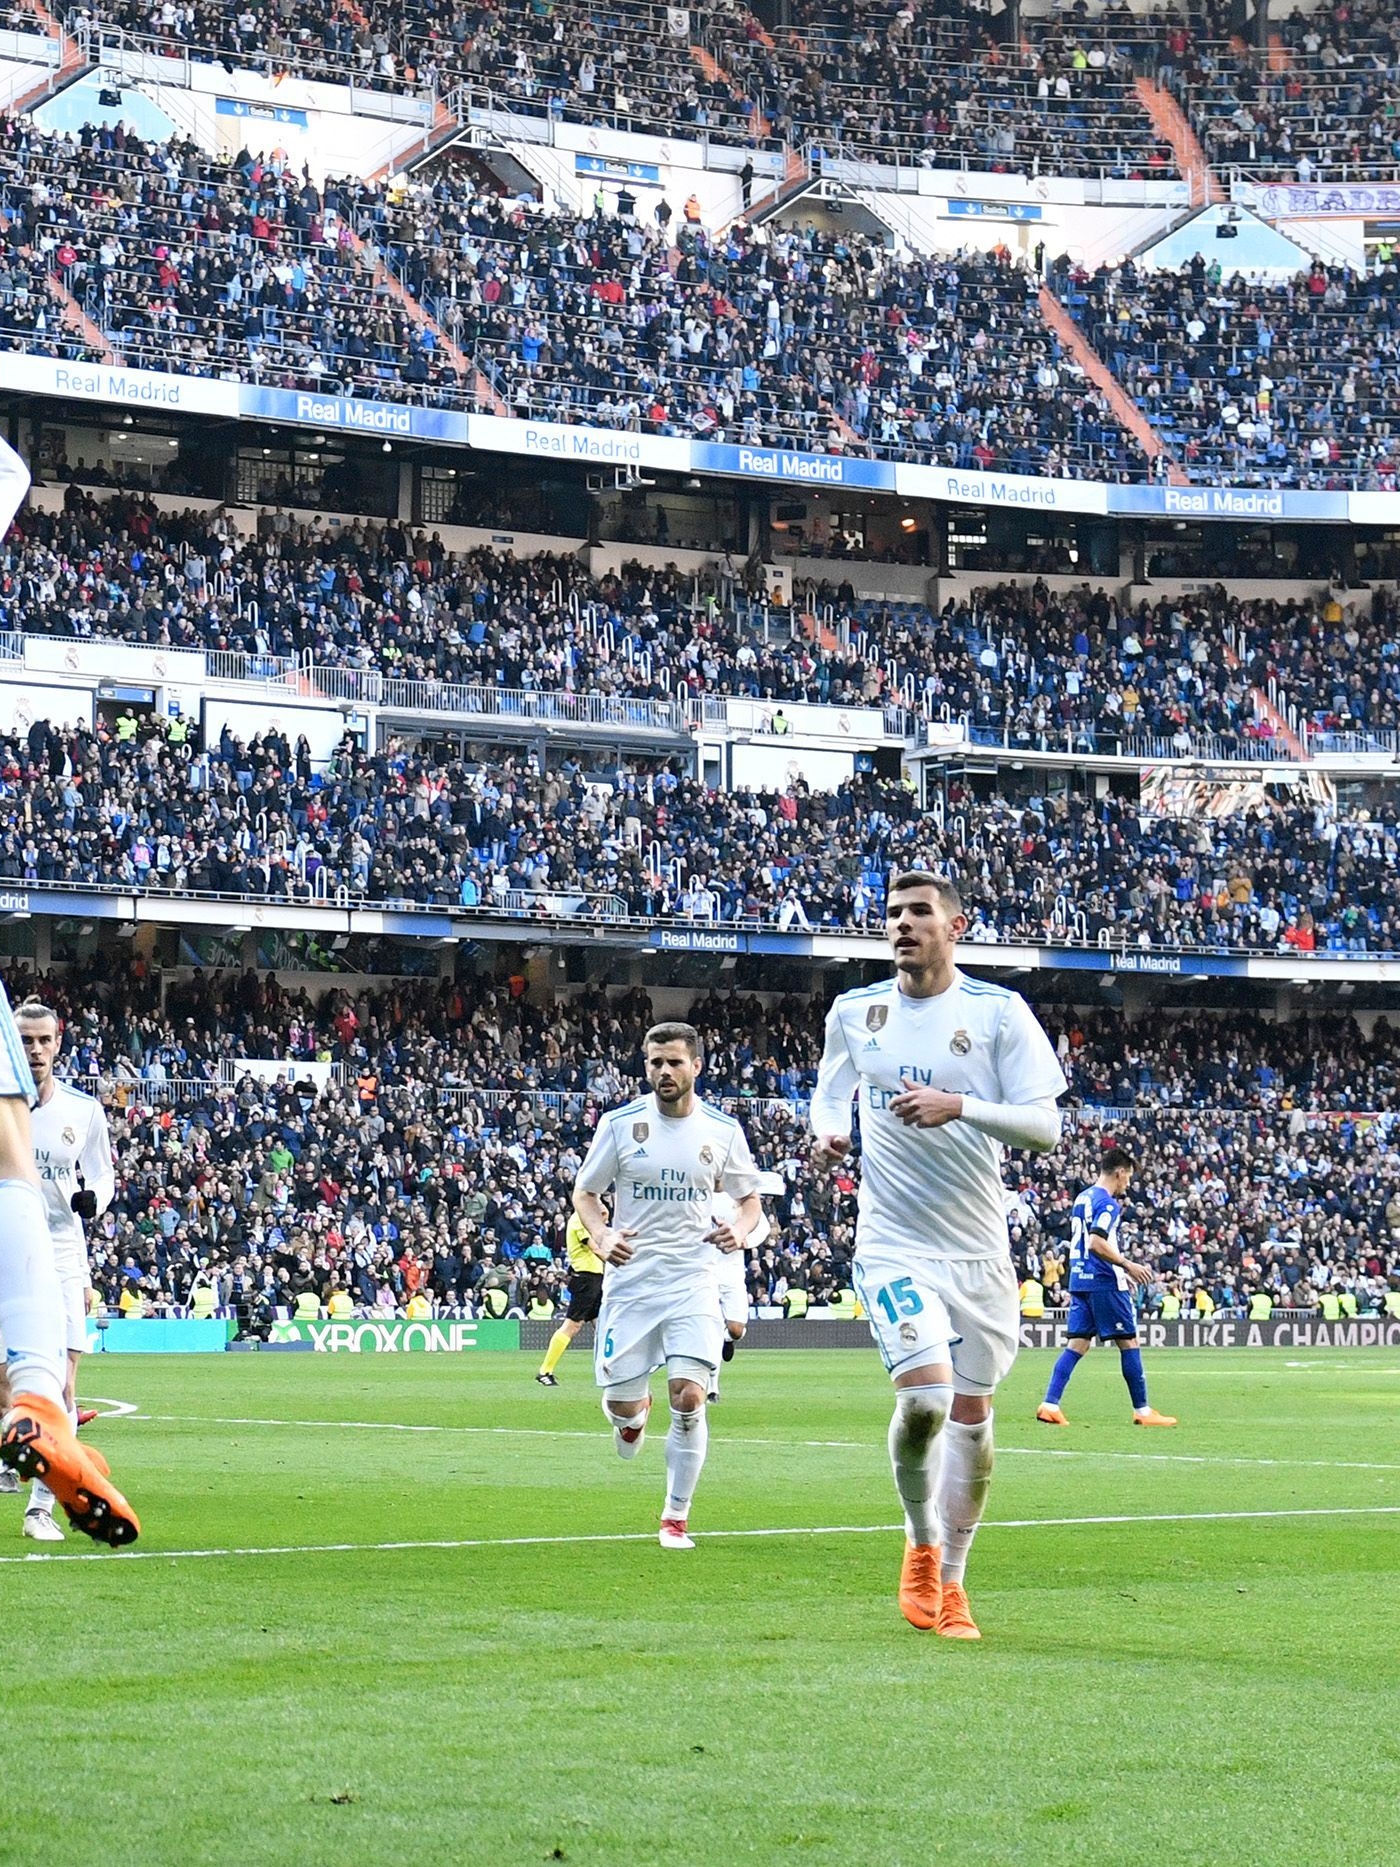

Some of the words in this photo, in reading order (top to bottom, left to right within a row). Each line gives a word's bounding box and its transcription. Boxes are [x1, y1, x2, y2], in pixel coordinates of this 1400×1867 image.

[56, 369, 101, 393] Real
[109, 376, 180, 403] Madrid
[298, 397, 339, 421] Real
[345, 403, 410, 431] Madrid
[526, 430, 566, 452] Real
[573, 435, 640, 459] Madrid
[739, 450, 778, 473] Real
[782, 456, 843, 481] Madrid
[947, 478, 985, 499] Real
[991, 483, 1055, 504] Madrid
[1165, 491, 1208, 512] Real
[1213, 493, 1282, 514] Madrid
[661, 931, 690, 947] Real
[692, 932, 737, 950] Madrid
[1110, 953, 1137, 969] Real
[1140, 955, 1180, 972] Madrid
[899, 1066, 932, 1086] Fly
[661, 1168, 686, 1184] Fly
[633, 1181, 708, 1202] Emirates
[877, 1276, 924, 1325] 15
[306, 1323, 398, 1352] XBOX
[403, 1323, 478, 1352] ONE
[603, 1328, 614, 1358] 6
[1246, 1323, 1264, 1347] A
